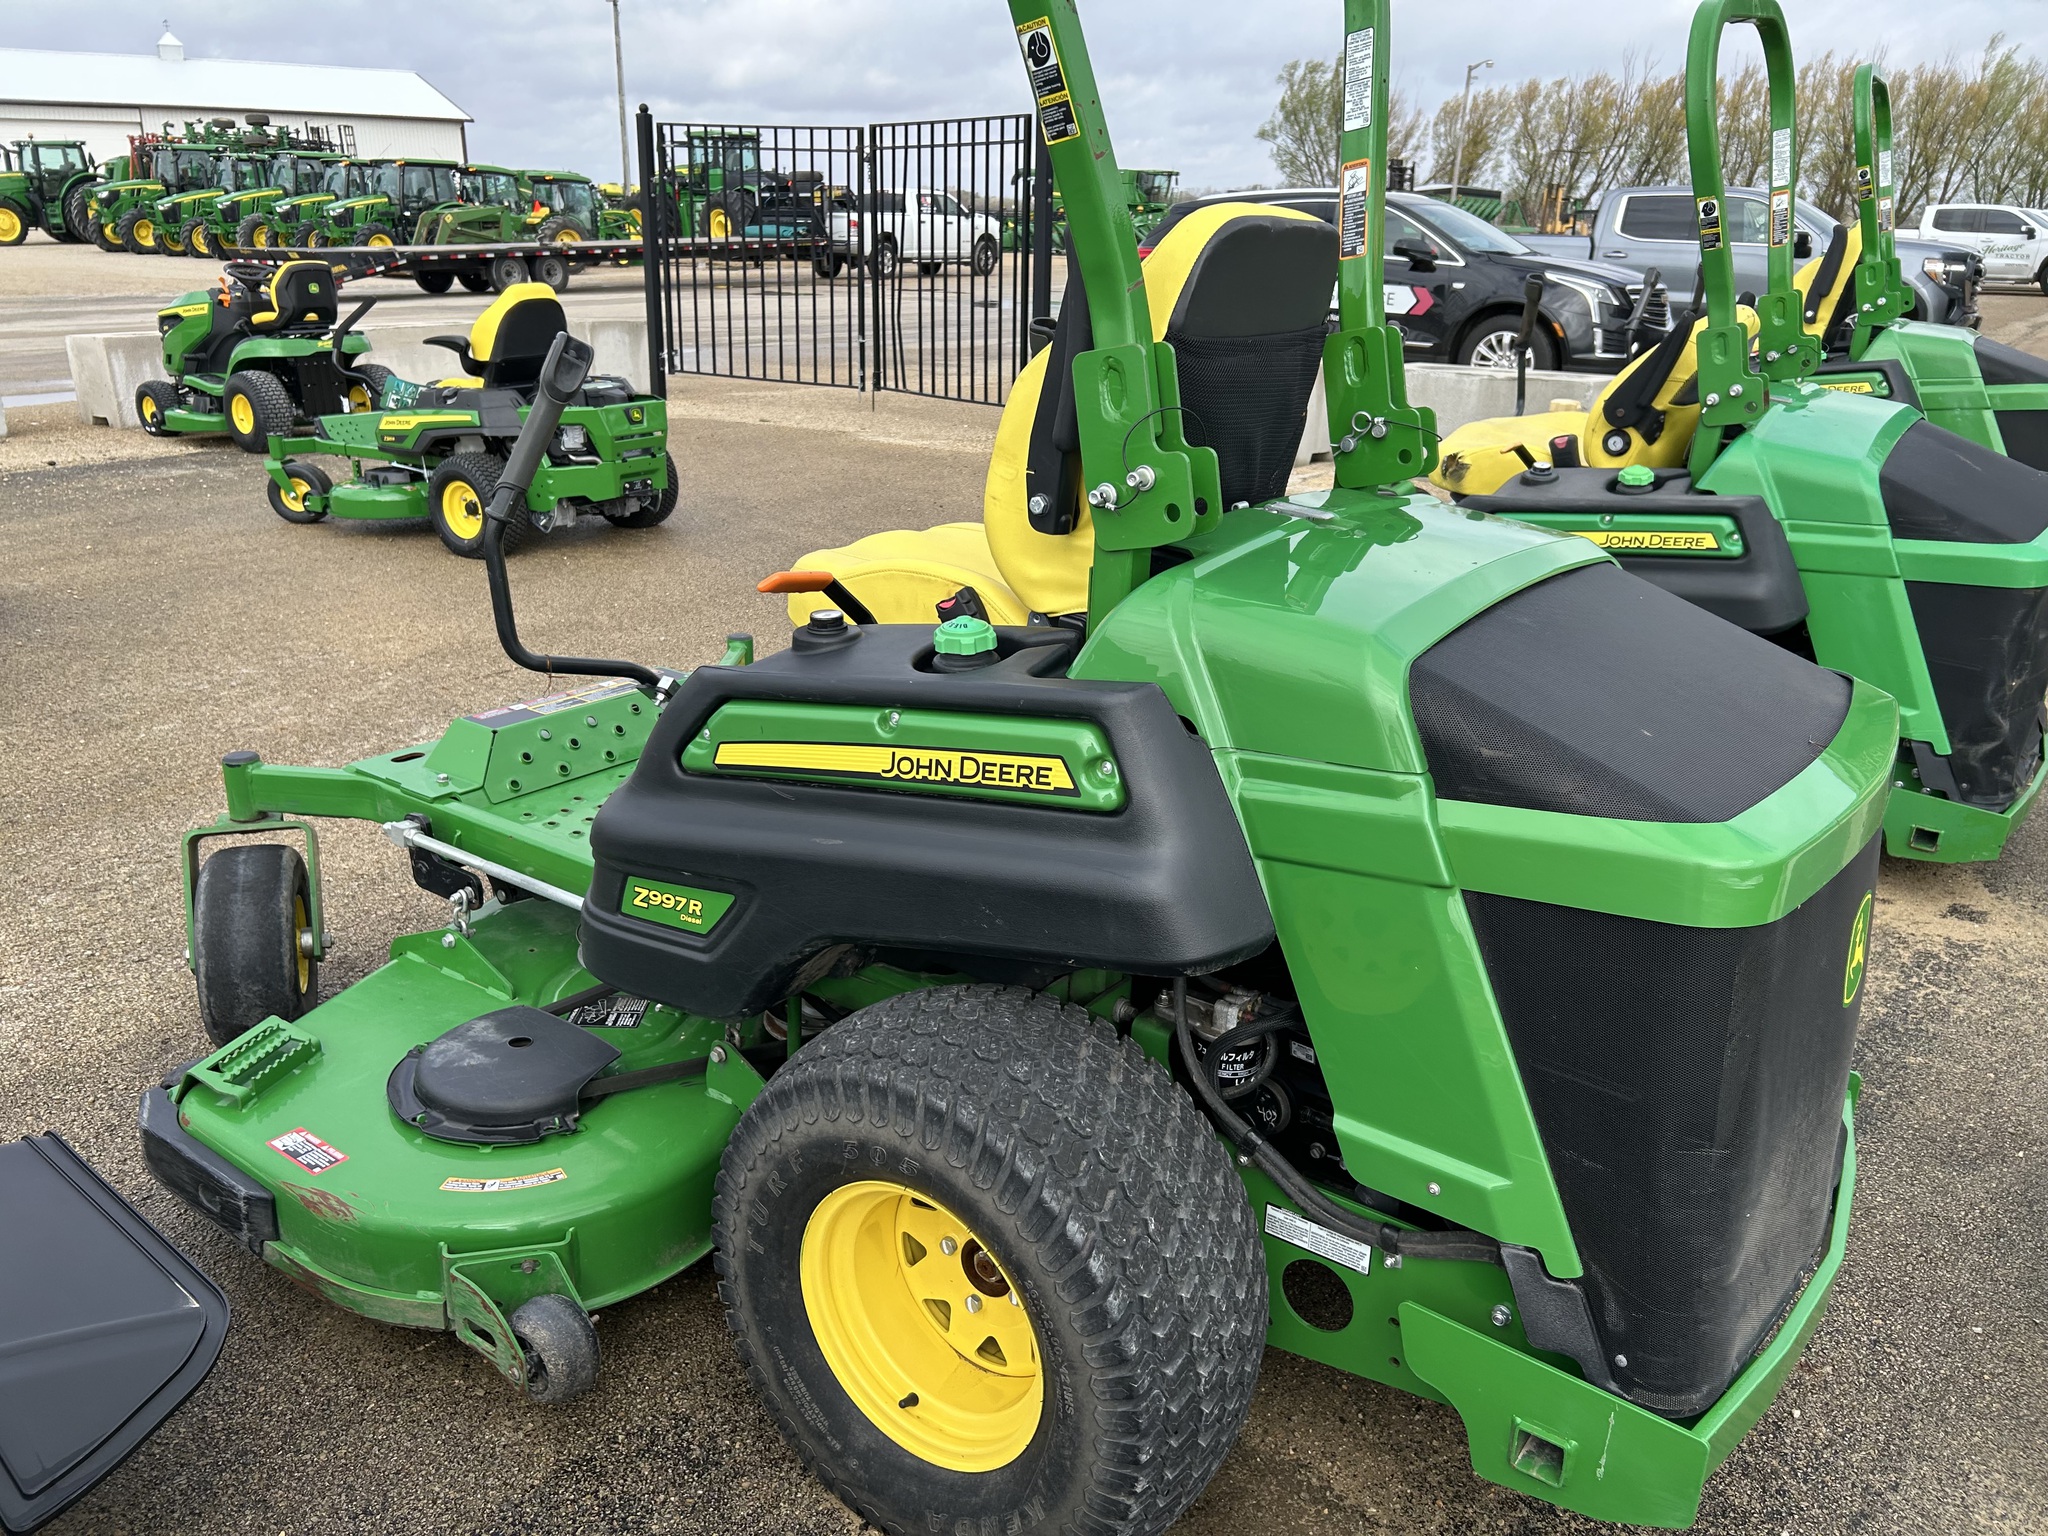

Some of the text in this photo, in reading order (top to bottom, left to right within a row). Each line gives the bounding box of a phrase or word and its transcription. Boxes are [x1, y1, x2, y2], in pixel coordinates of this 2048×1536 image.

[1022, 18, 1047, 32] CAUTION
[1981, 242, 2026, 255] Heritage
[1599, 533, 1707, 548] JOHN DEERE
[881, 750, 1054, 787] JOHN DEERE
[632, 884, 704, 917] Z997R
[679, 913, 703, 925] Diesel
[1221, 1063, 1245, 1071] FILTER
[747, 1139, 920, 1255] TURF 505
[924, 1494, 1046, 1536] KENDA
